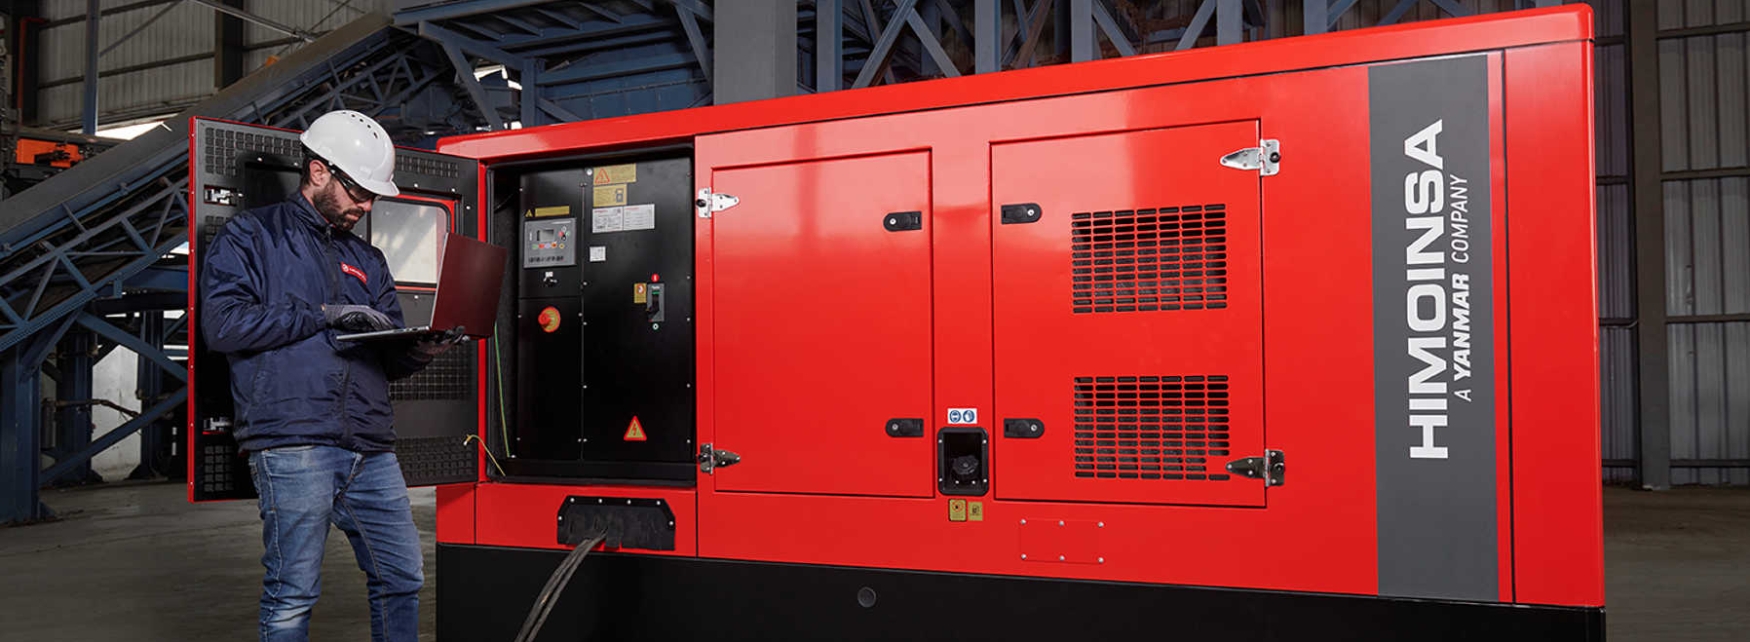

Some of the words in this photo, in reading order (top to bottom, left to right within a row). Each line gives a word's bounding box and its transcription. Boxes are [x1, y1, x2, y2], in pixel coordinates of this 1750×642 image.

[1450, 174, 1469, 264] COMPANY
[1404, 118, 1449, 459] HIMOINSA
[1452, 273, 1471, 382] YANMAR
[1453, 388, 1472, 402] A
